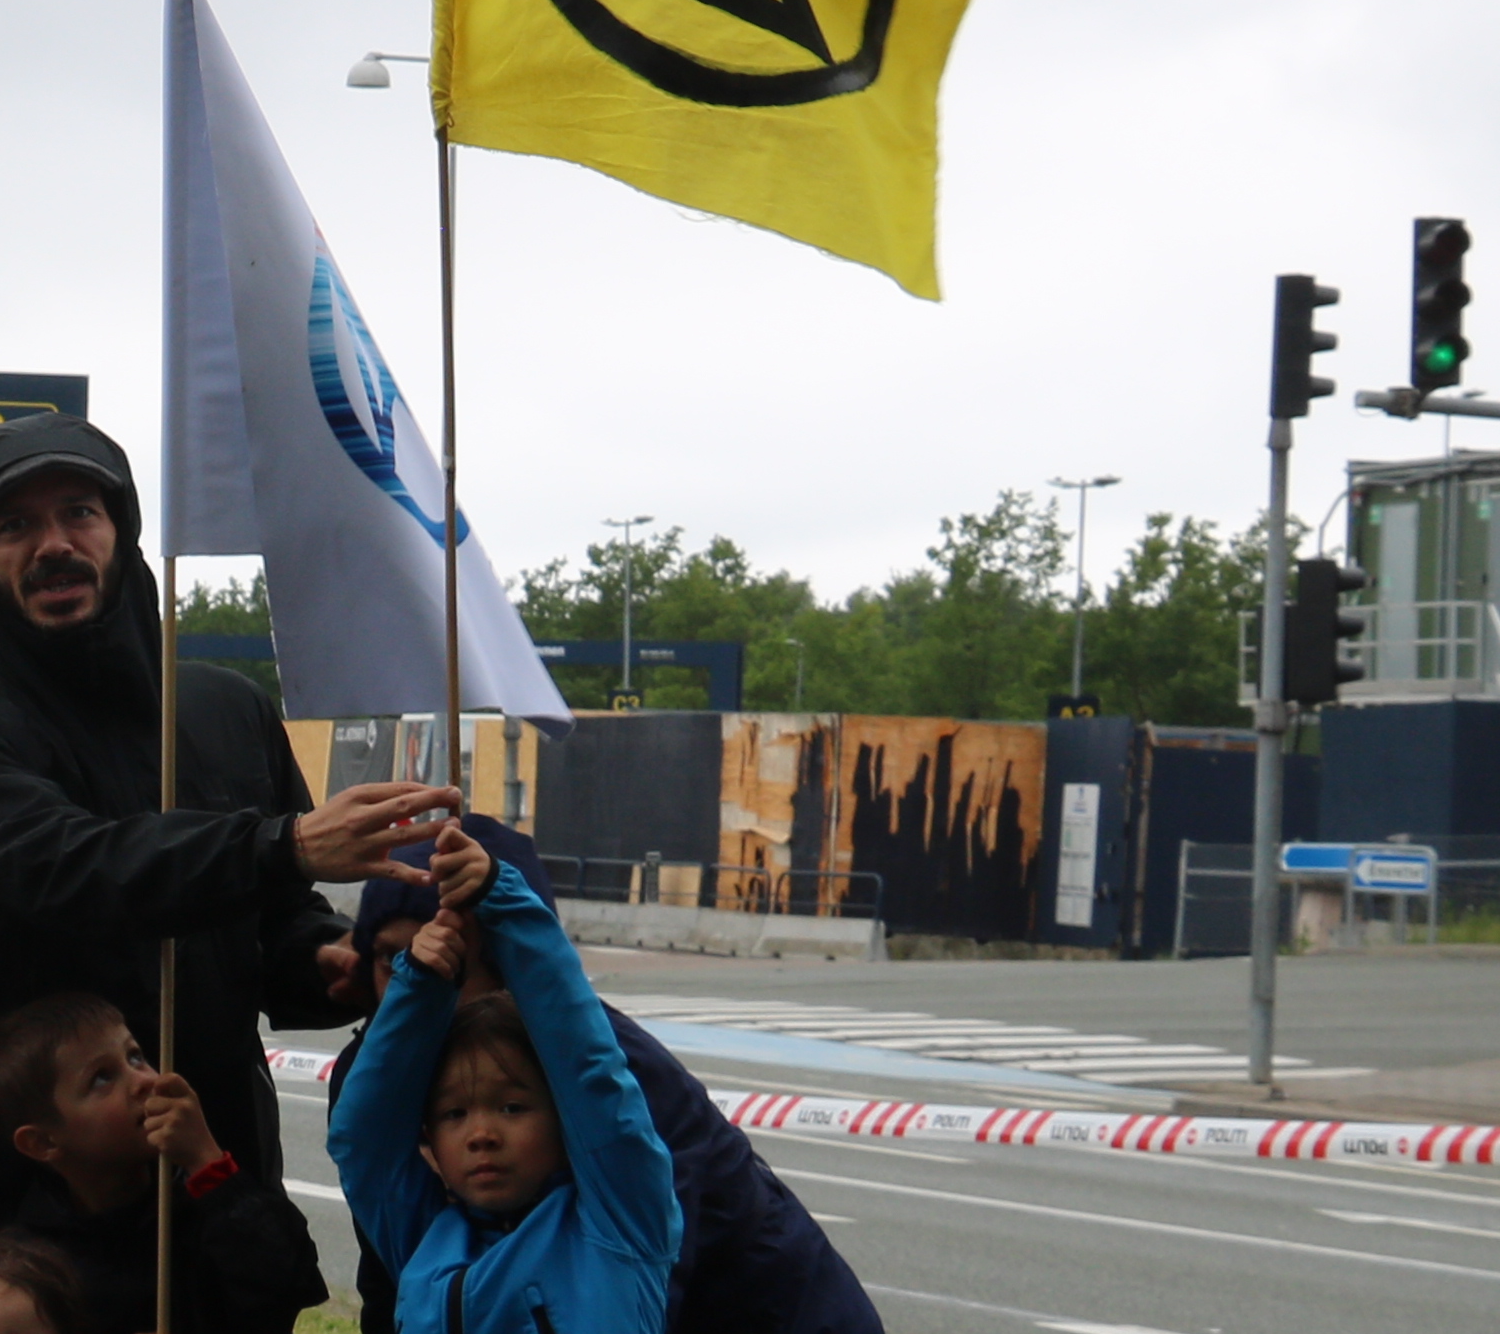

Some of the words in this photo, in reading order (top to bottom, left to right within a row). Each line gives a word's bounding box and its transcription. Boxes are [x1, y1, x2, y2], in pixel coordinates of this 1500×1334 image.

[287, 1056, 317, 1070] POLITI
[932, 1113, 972, 1130] POLITI
[1205, 1127, 1249, 1144] POLITI
